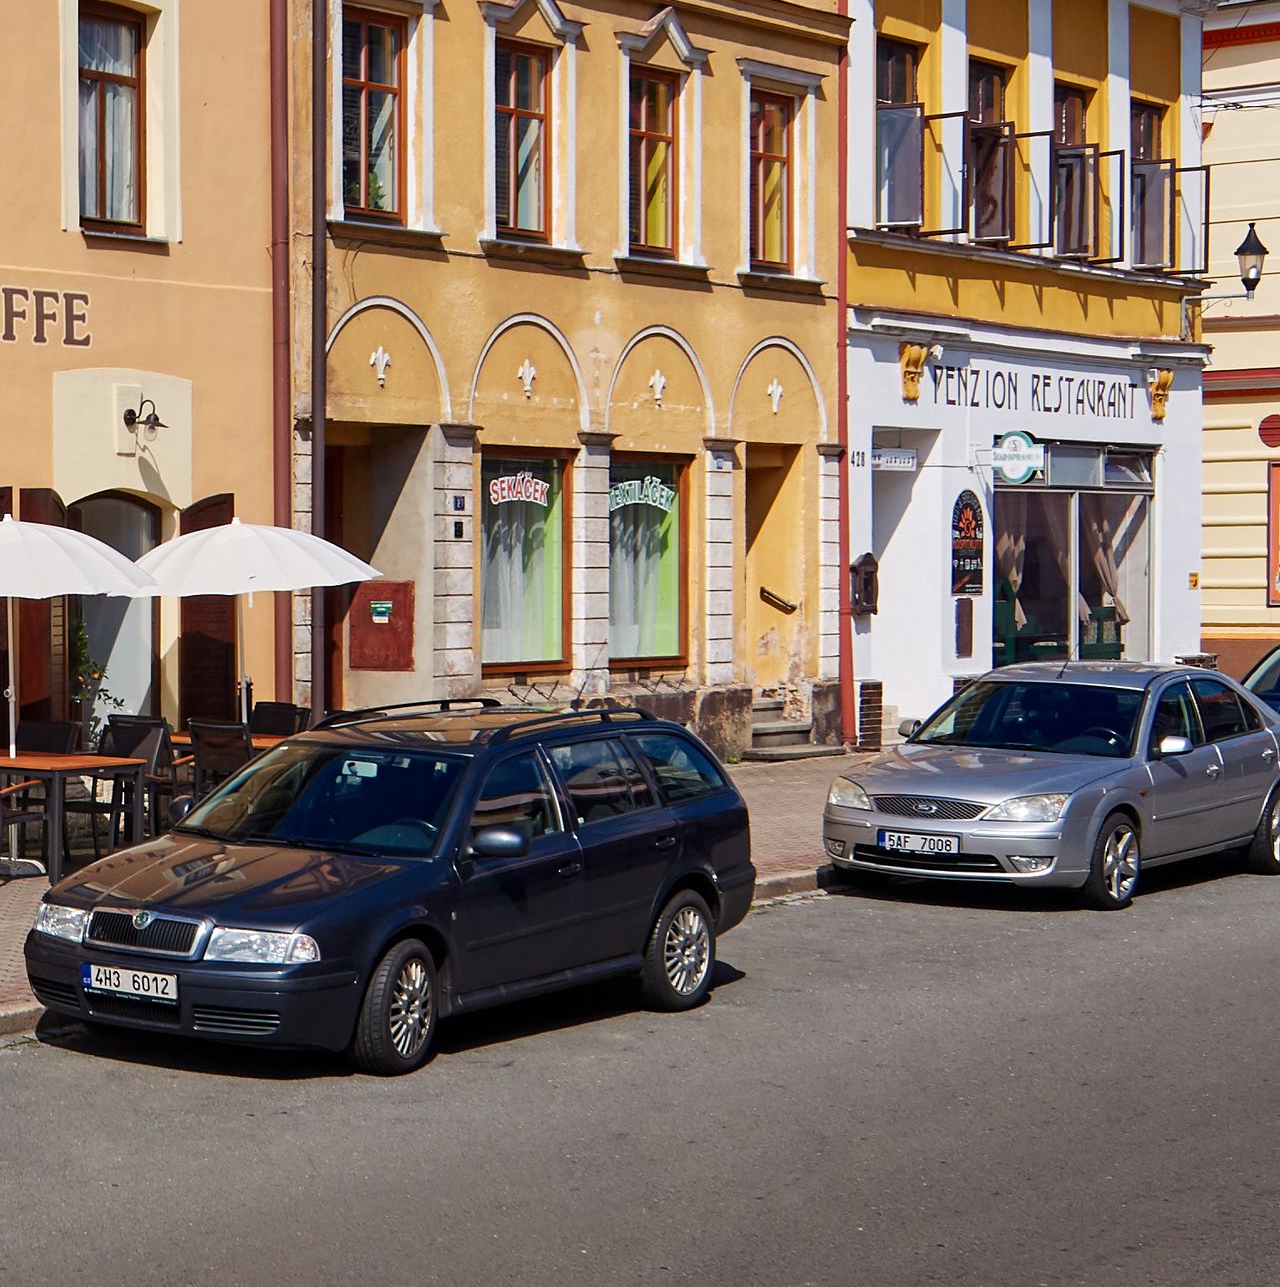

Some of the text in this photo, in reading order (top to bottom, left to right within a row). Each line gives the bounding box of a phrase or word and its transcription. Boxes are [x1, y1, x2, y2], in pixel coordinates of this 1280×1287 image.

[934, 365, 1138, 419] PENZION RESTAURANT
[490, 471, 549, 507] SEKÁČEK
[888, 834, 952, 852] 5AF 7008
[95, 968, 169, 995] 4H3 6012
